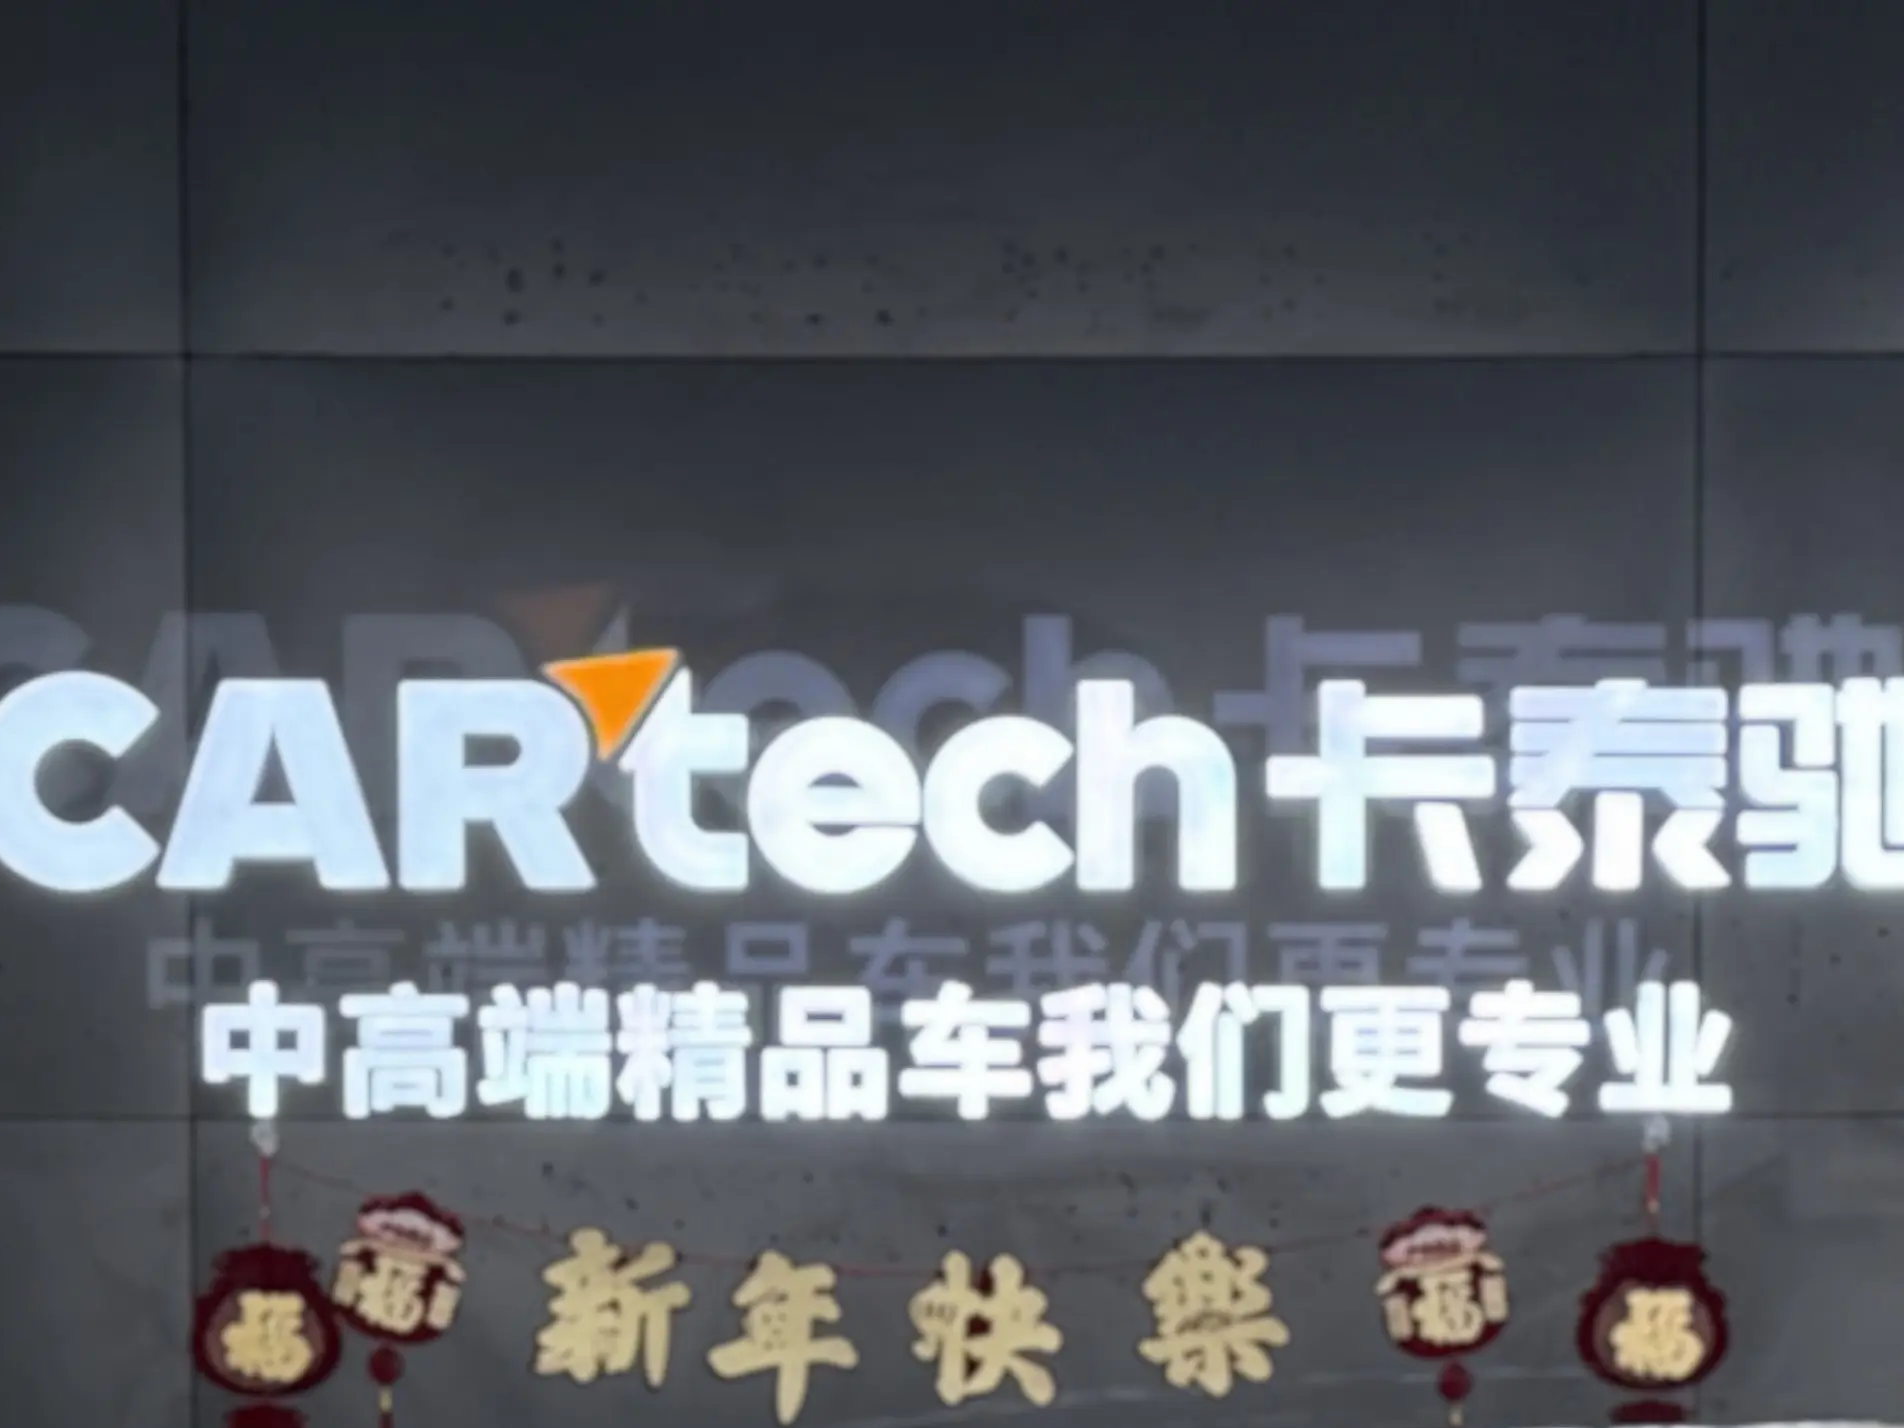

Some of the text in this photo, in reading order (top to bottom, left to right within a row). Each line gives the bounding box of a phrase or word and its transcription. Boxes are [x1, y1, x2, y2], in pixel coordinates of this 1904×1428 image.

[198, 979, 1734, 1121] 中高端精品车我们更专业
